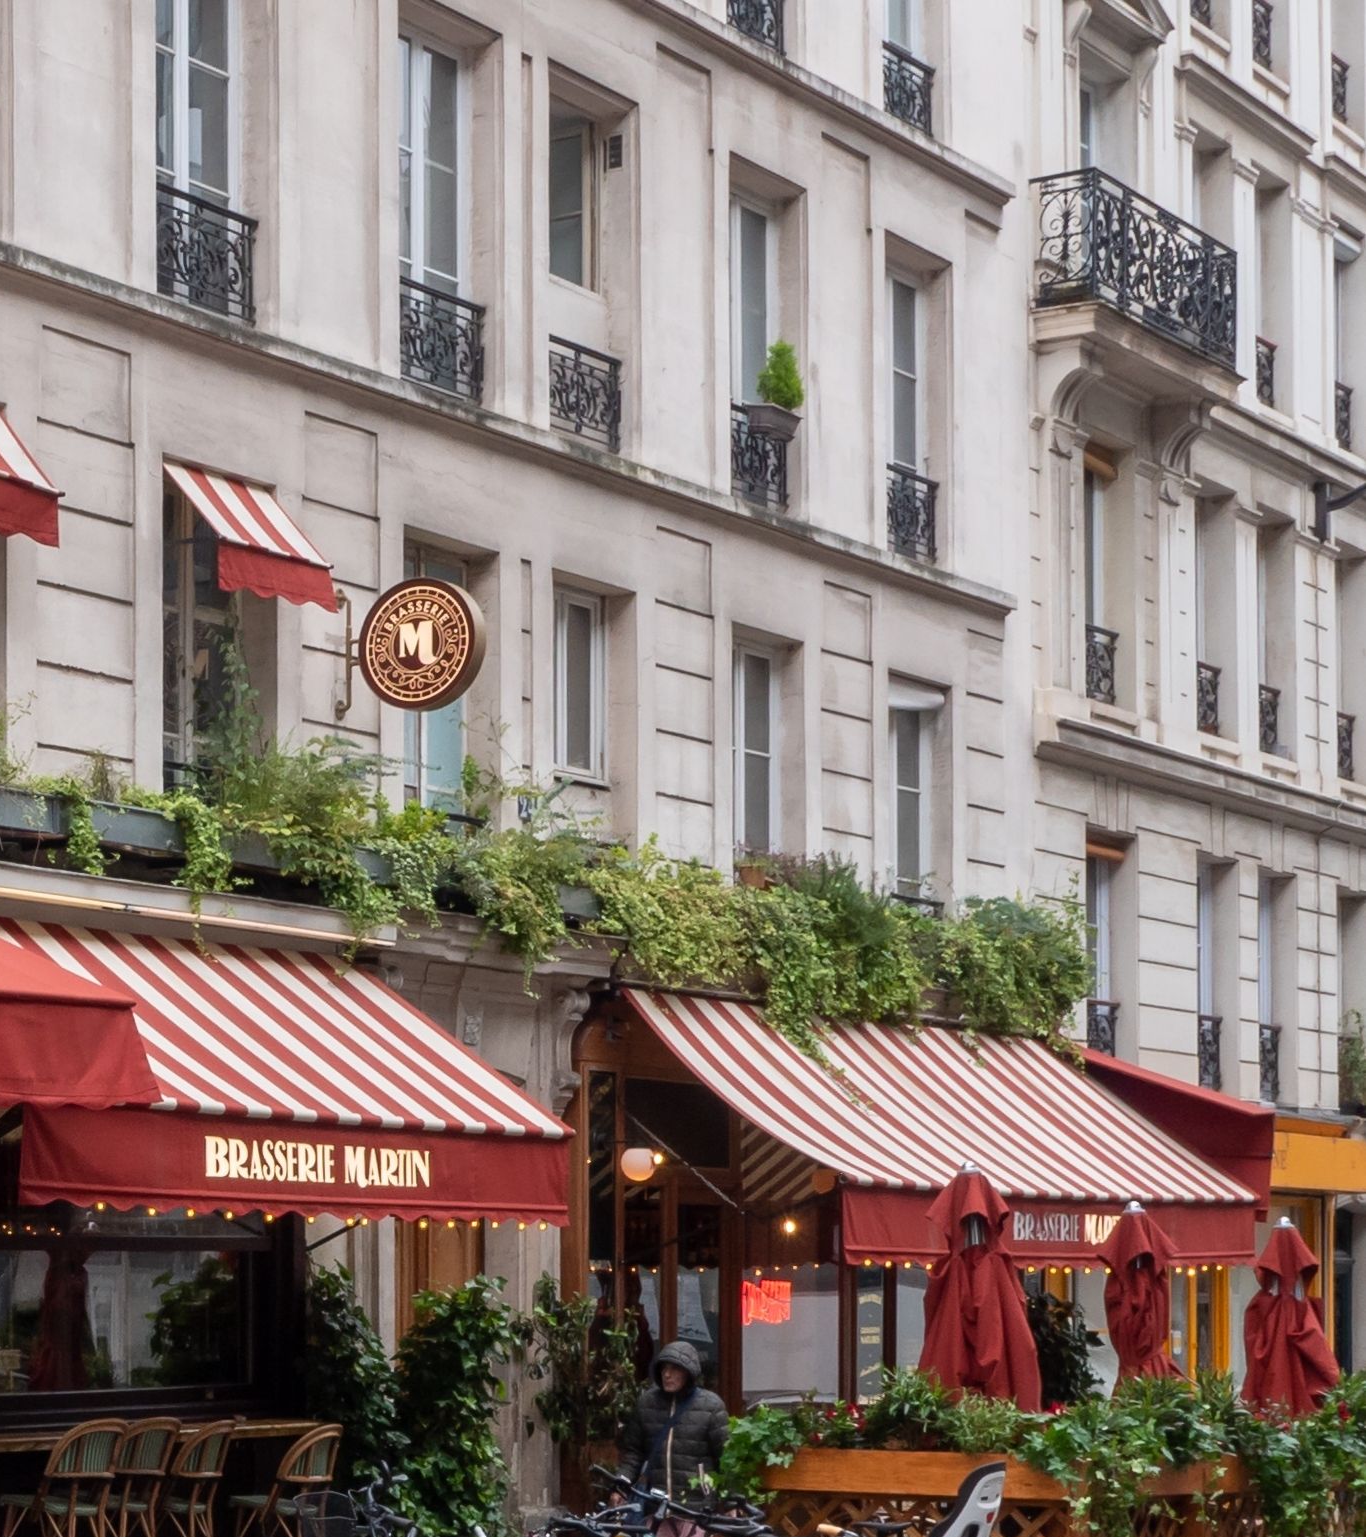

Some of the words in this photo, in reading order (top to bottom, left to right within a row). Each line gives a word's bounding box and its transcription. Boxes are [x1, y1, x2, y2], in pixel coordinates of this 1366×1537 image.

[384, 600, 450, 631] BRASSERIE
[398, 620, 438, 665] M
[204, 1135, 336, 1184] BRASSERIE
[344, 1145, 430, 1189] MARTIN
[1012, 1211, 1080, 1243] BRASSERIE
